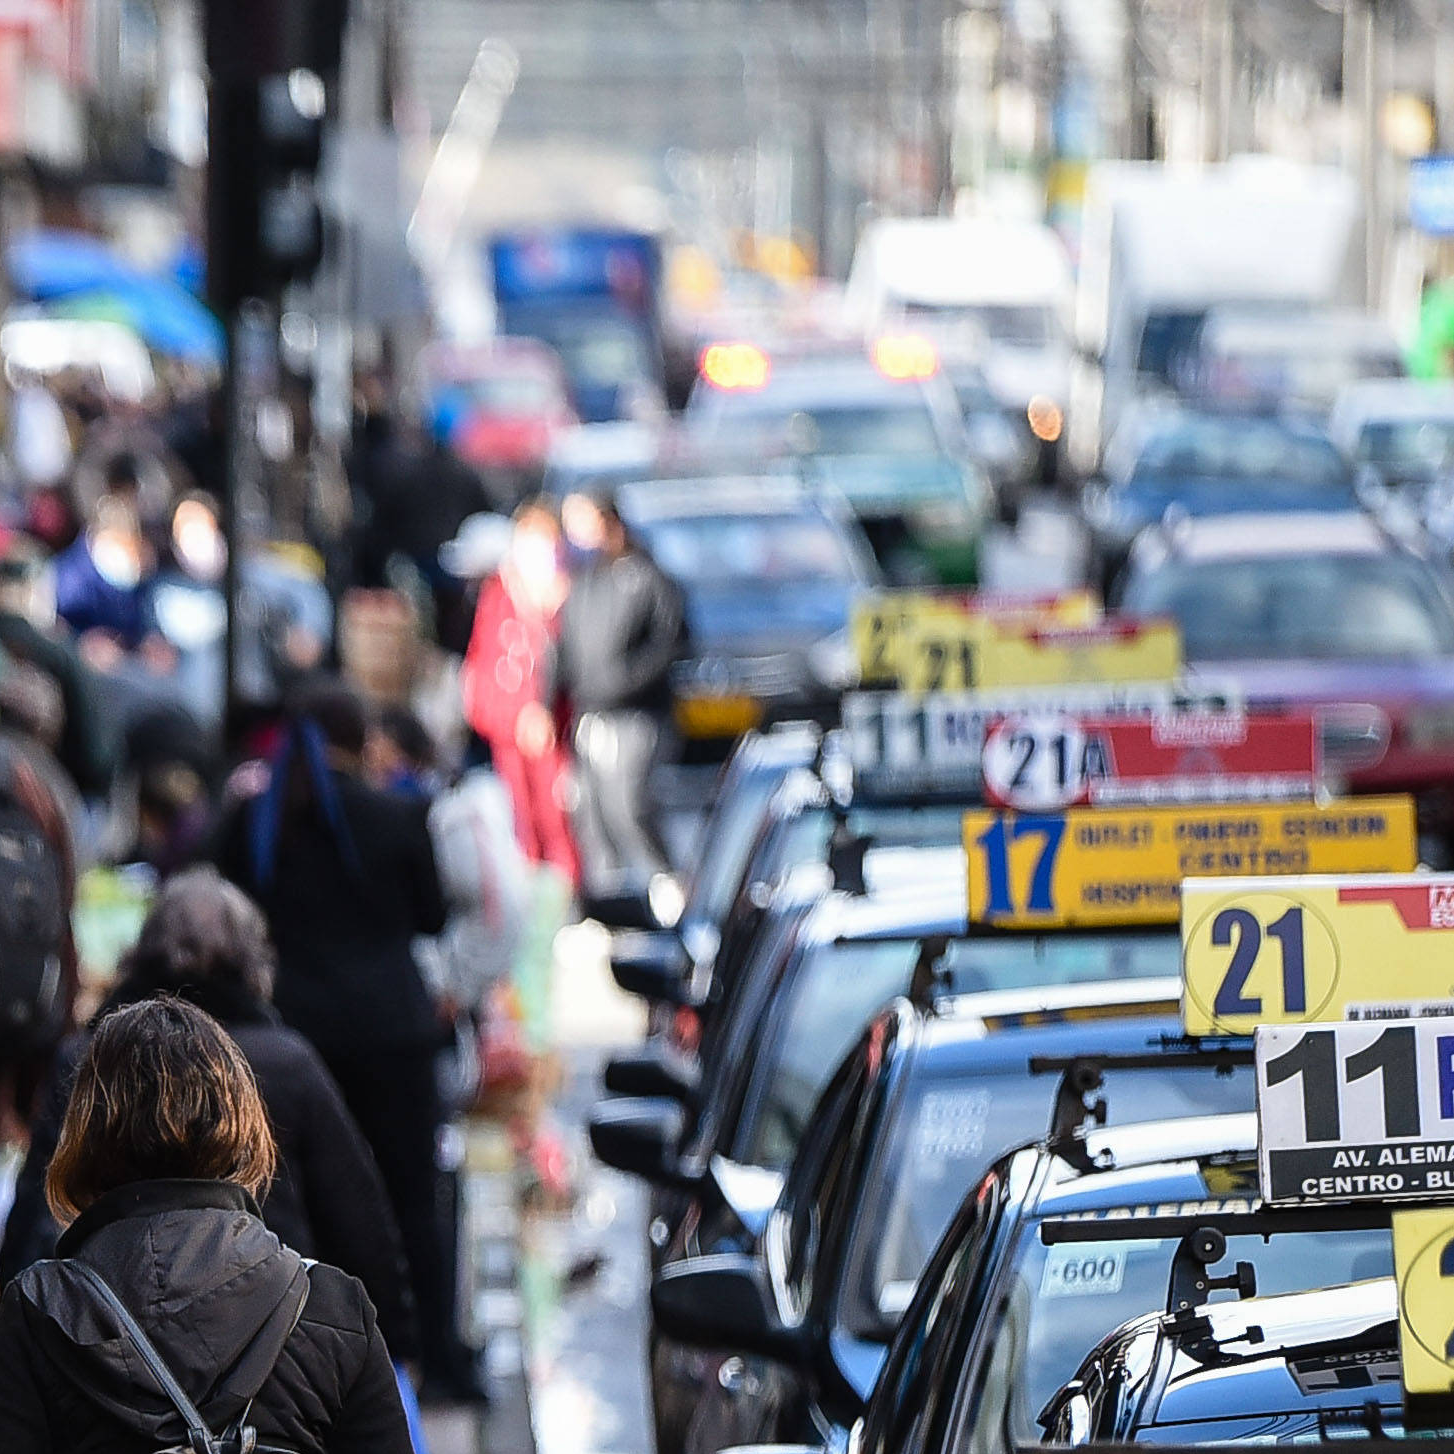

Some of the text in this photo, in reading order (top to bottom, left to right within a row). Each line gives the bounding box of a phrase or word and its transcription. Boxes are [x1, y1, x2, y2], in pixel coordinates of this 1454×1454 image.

[977, 813, 1067, 916] 17
[1212, 907, 1307, 1016] 21
[1266, 1026, 1421, 1143] 11
[1301, 1173, 1404, 1195] CENTRO
[1333, 1149, 1371, 1169] AV.
